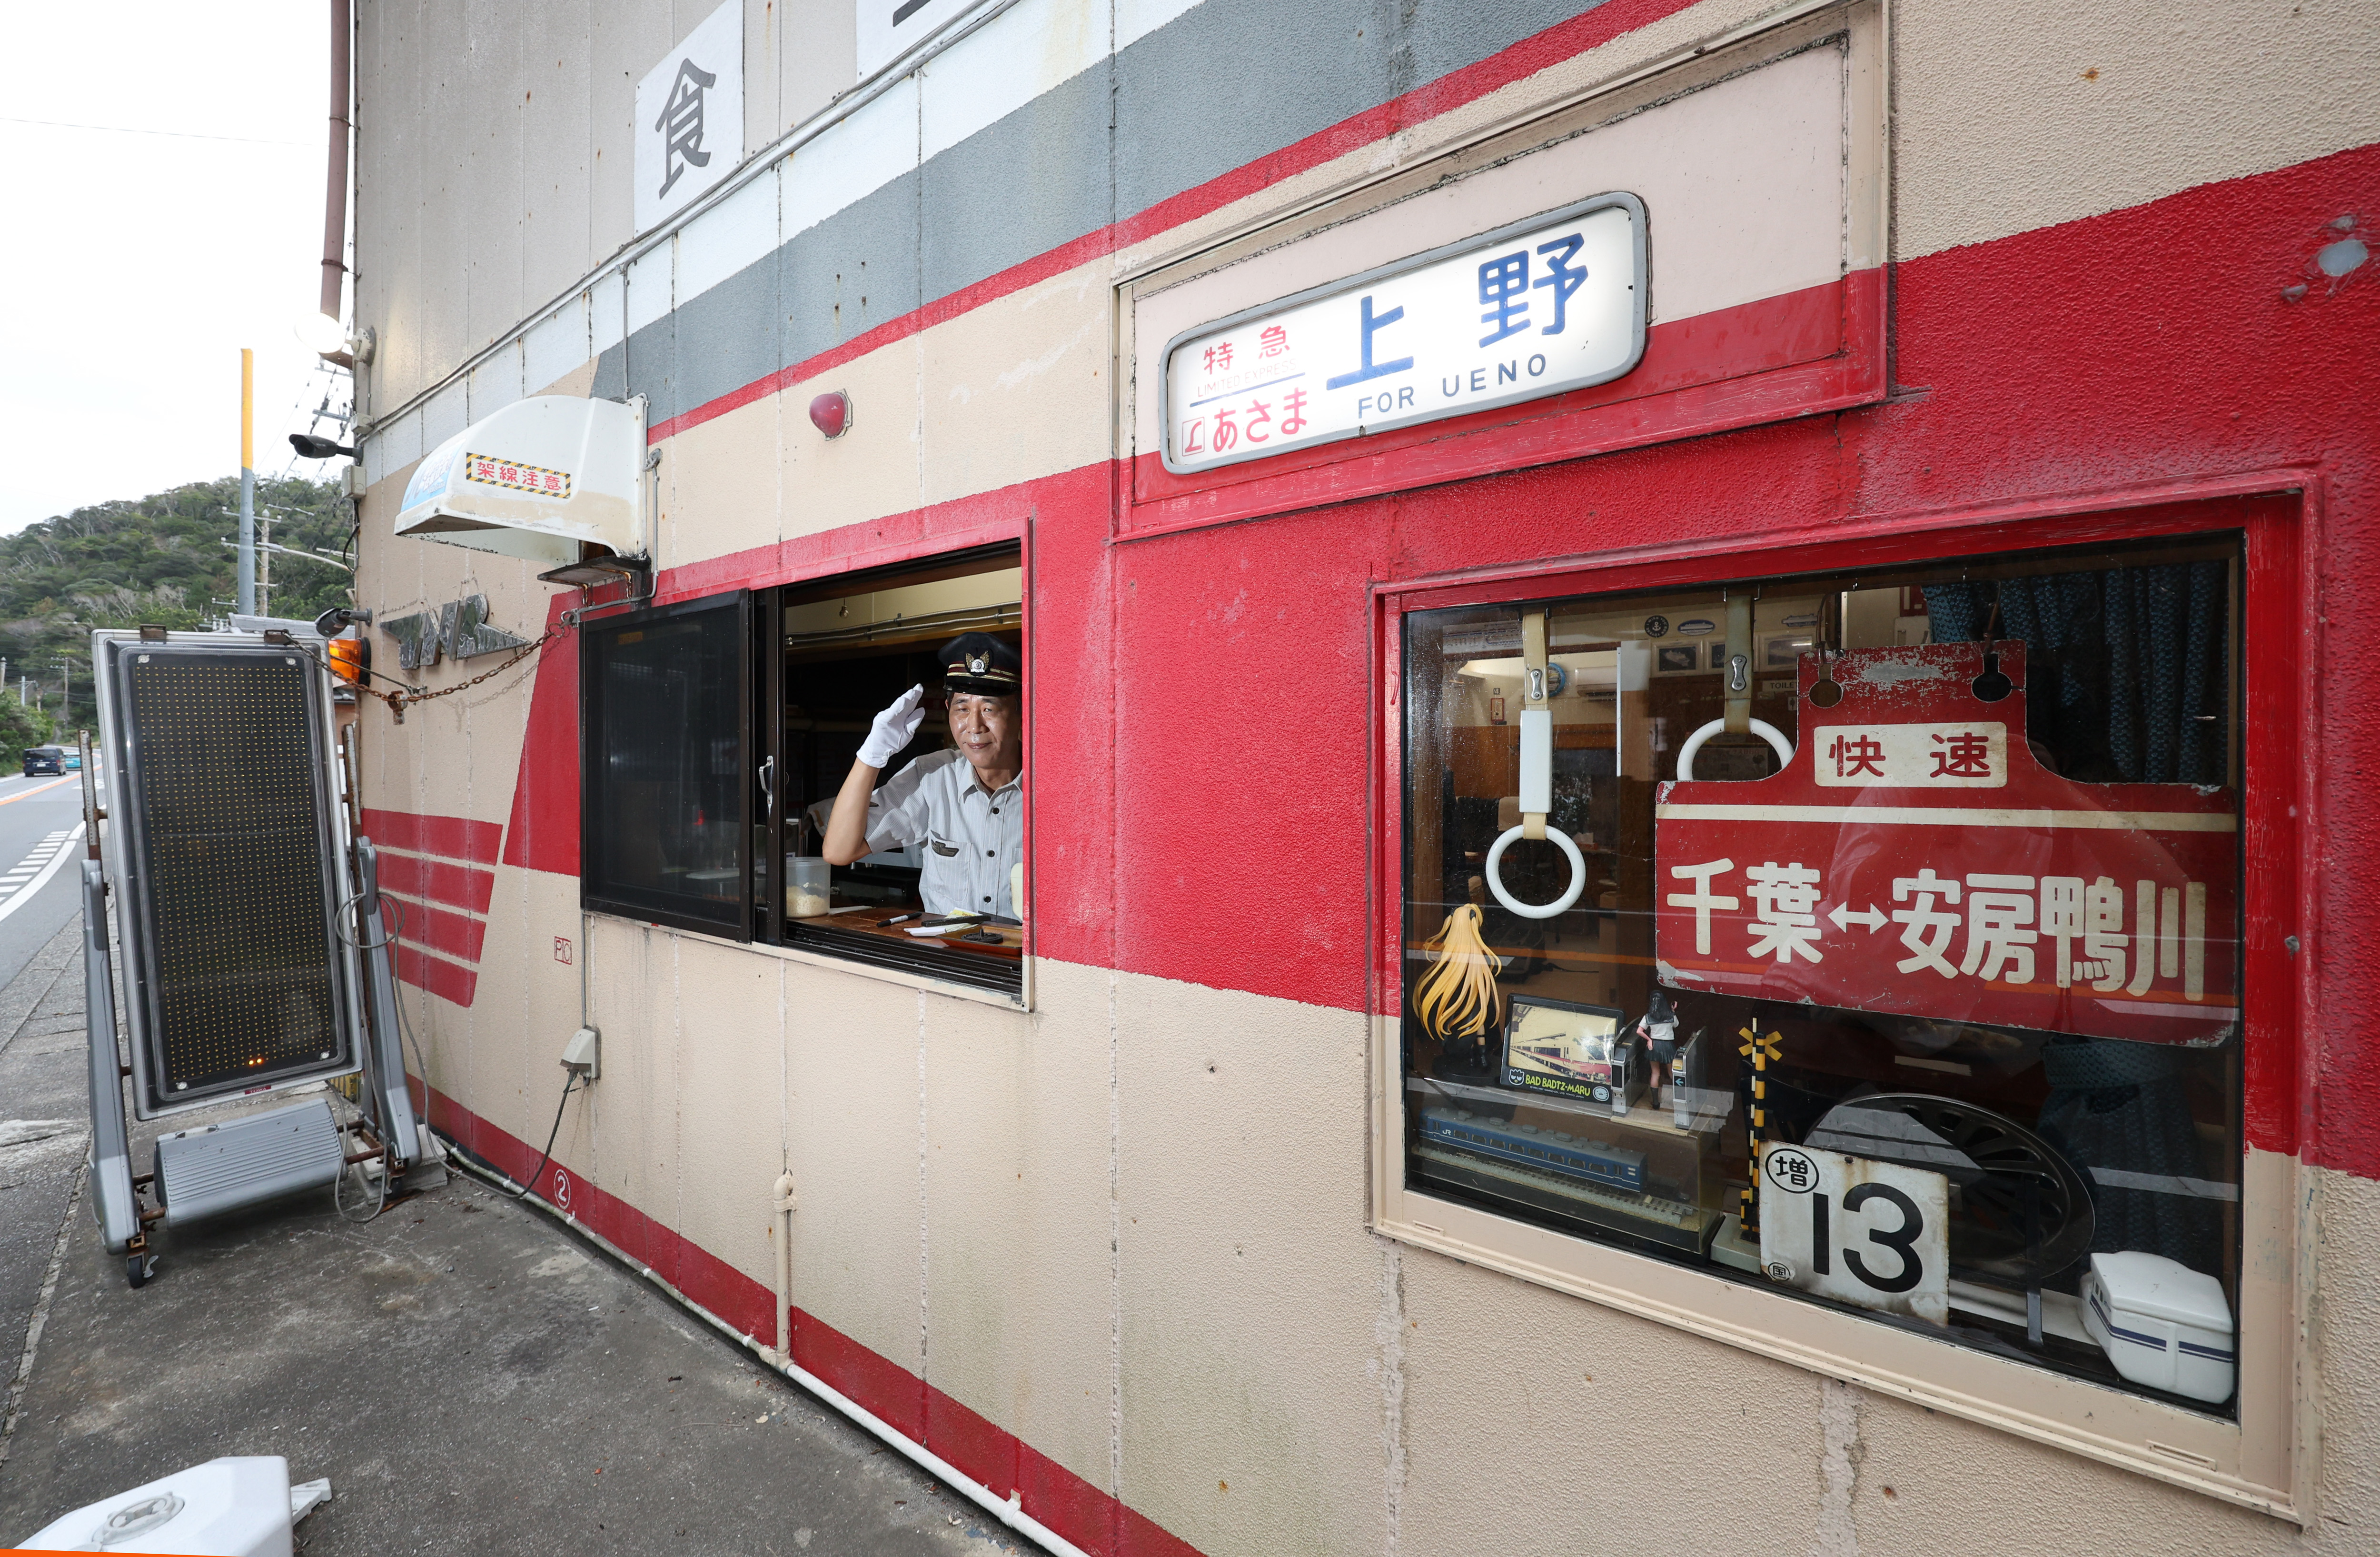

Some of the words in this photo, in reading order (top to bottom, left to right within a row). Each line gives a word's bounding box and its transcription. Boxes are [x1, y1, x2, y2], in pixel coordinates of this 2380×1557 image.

[655, 58, 716, 200] 食
[1326, 232, 1588, 390] 上野
[1203, 325, 1290, 375] 特急
[1198, 375, 1240, 397] LIMITED
[1245, 359, 1296, 383] EXPRESS
[1358, 386, 1414, 419] FOR
[1442, 353, 1547, 397] UENO
[1213, 387, 1307, 452] あさま
[477, 461, 561, 490] 架線注意
[1829, 732, 1991, 778] 快速
[1666, 858, 1824, 964] 千葉
[1891, 868, 2206, 1001] 安房鴨川
[1525, 1074, 1541, 1086] BAD
[1542, 1078, 1591, 1097] BADTZ-MARU
[1775, 1156, 1808, 1187] 増
[1813, 1182, 1923, 1293] 13
[1773, 1265, 1786, 1277] 国
